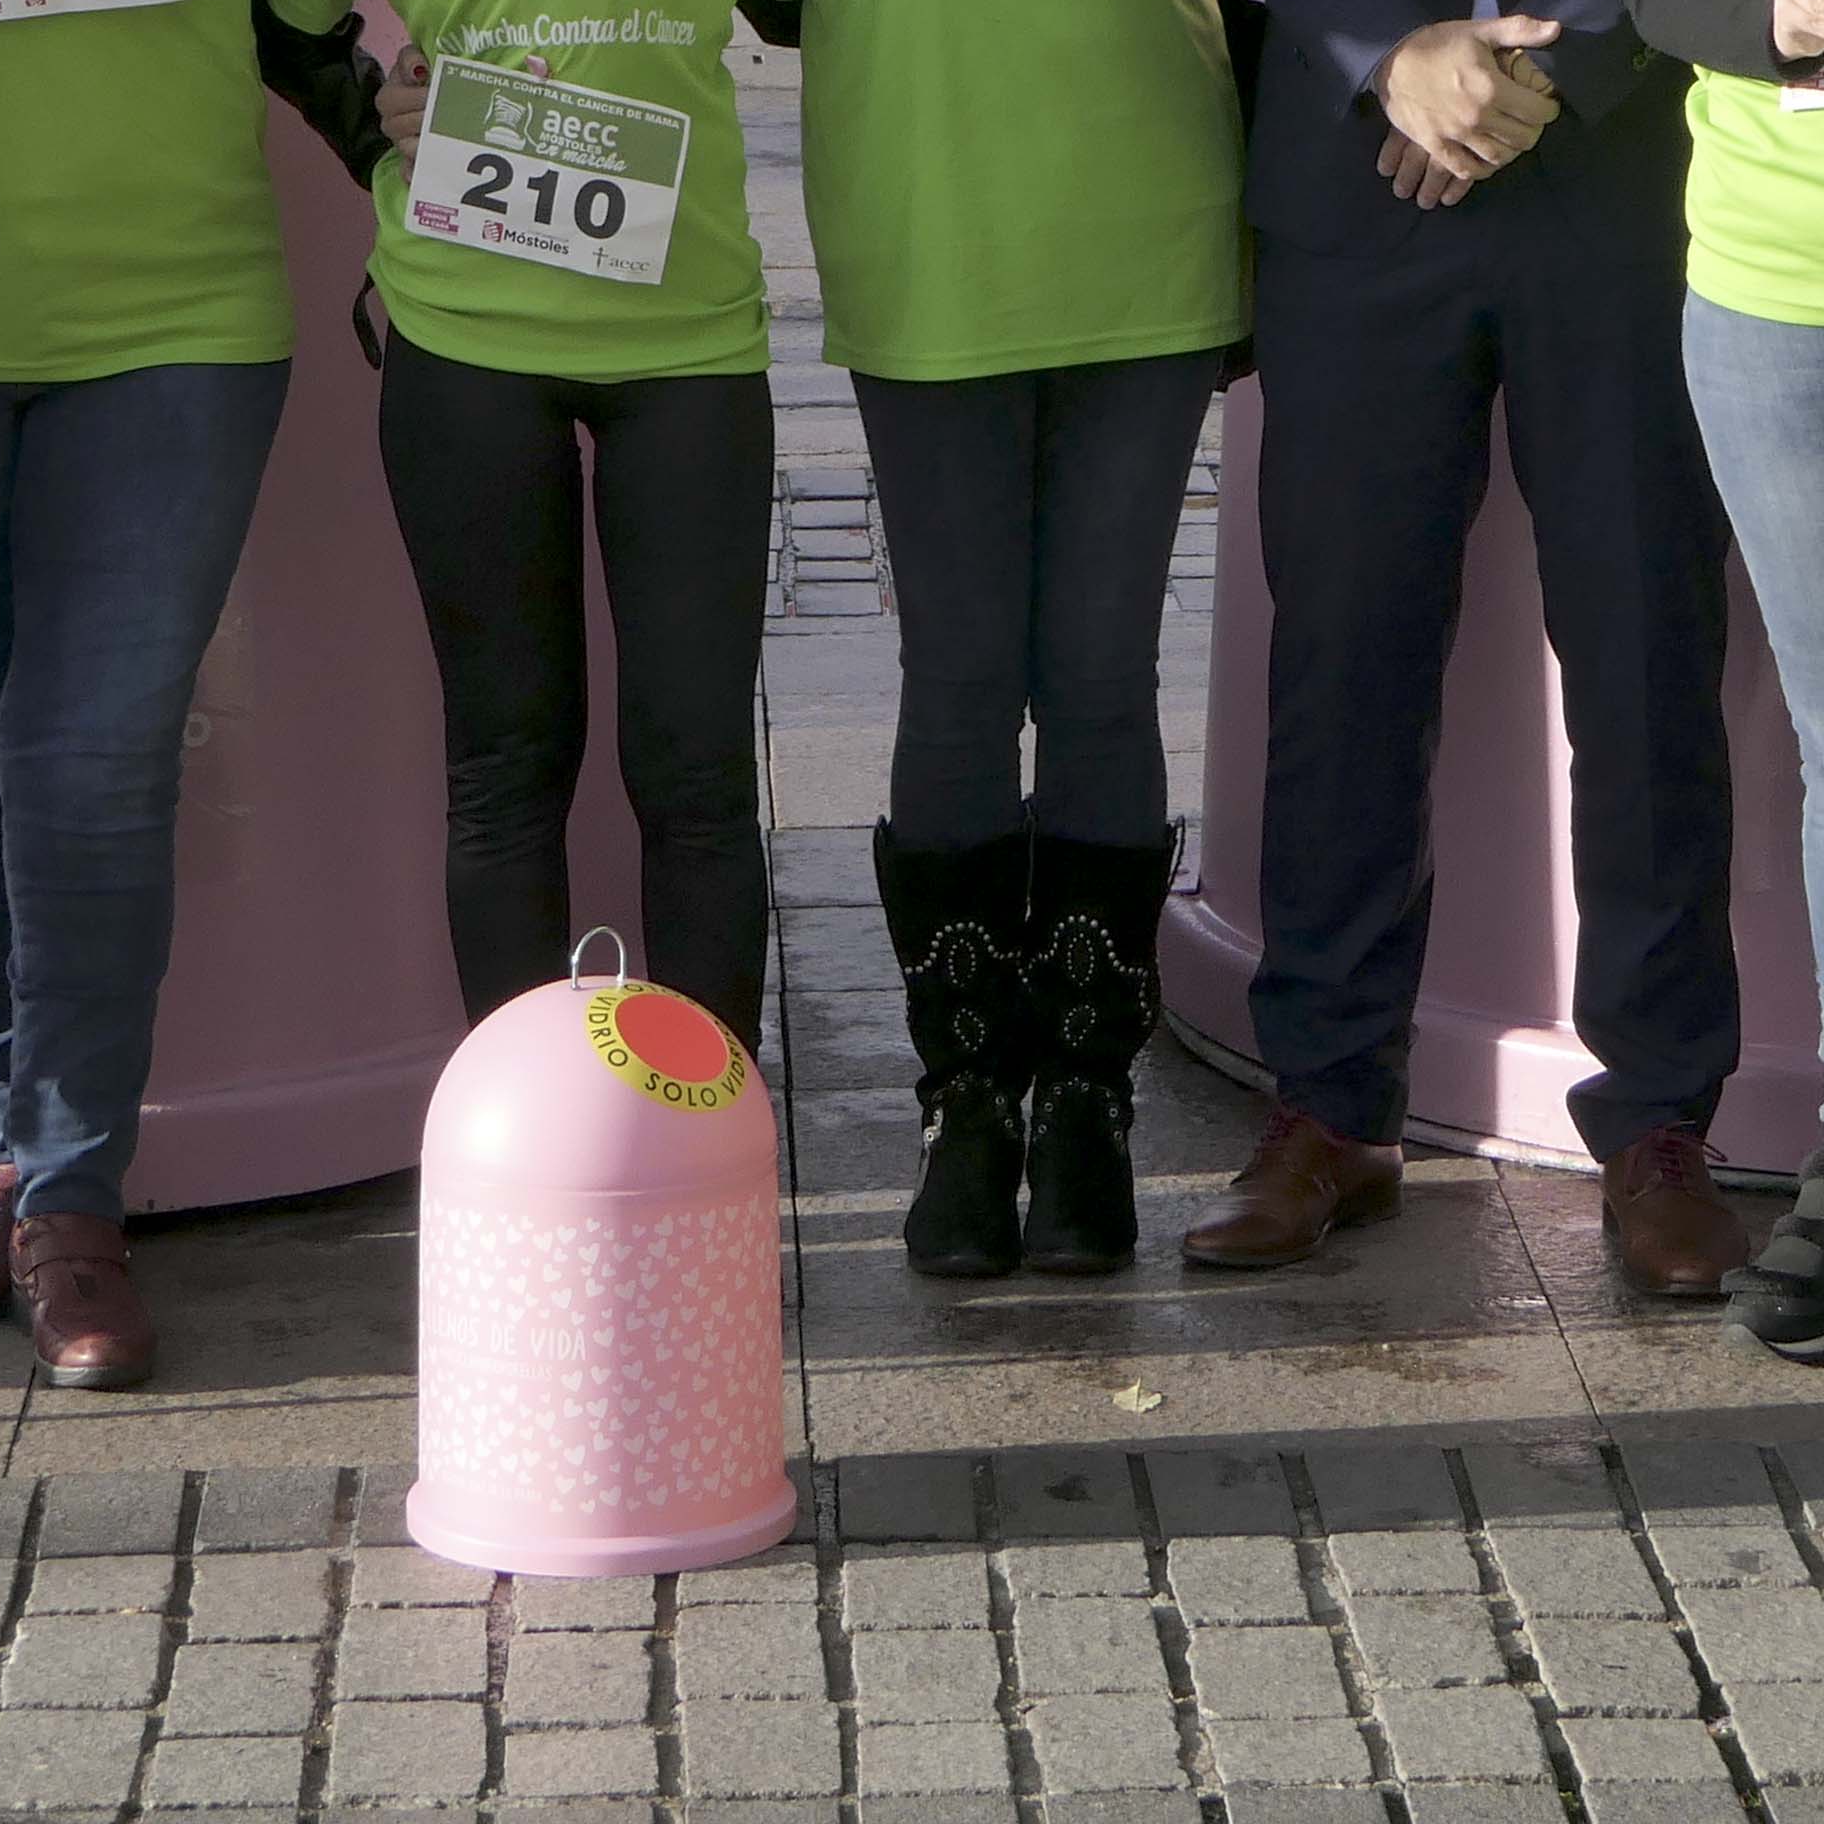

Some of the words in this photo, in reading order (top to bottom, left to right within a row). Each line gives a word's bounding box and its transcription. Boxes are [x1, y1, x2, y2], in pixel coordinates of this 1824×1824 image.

[462, 16, 533, 54] Marcha
[533, 13, 618, 47] Contra
[621, 7, 642, 44] el
[644, 8, 697, 46] Cáncer
[459, 67, 512, 89] MARCHA
[512, 79, 560, 102] CONTRA
[560, 91, 576, 106] EL
[625, 106, 643, 121] DE
[644, 111, 680, 130] MAMA
[542, 109, 619, 148] aecc
[561, 147, 629, 174] marcha
[459, 152, 627, 241] 210
[503, 227, 570, 256] Móstoles
[588, 995, 629, 1067] VIDRIO
[644, 1072, 718, 1108] SOLO
